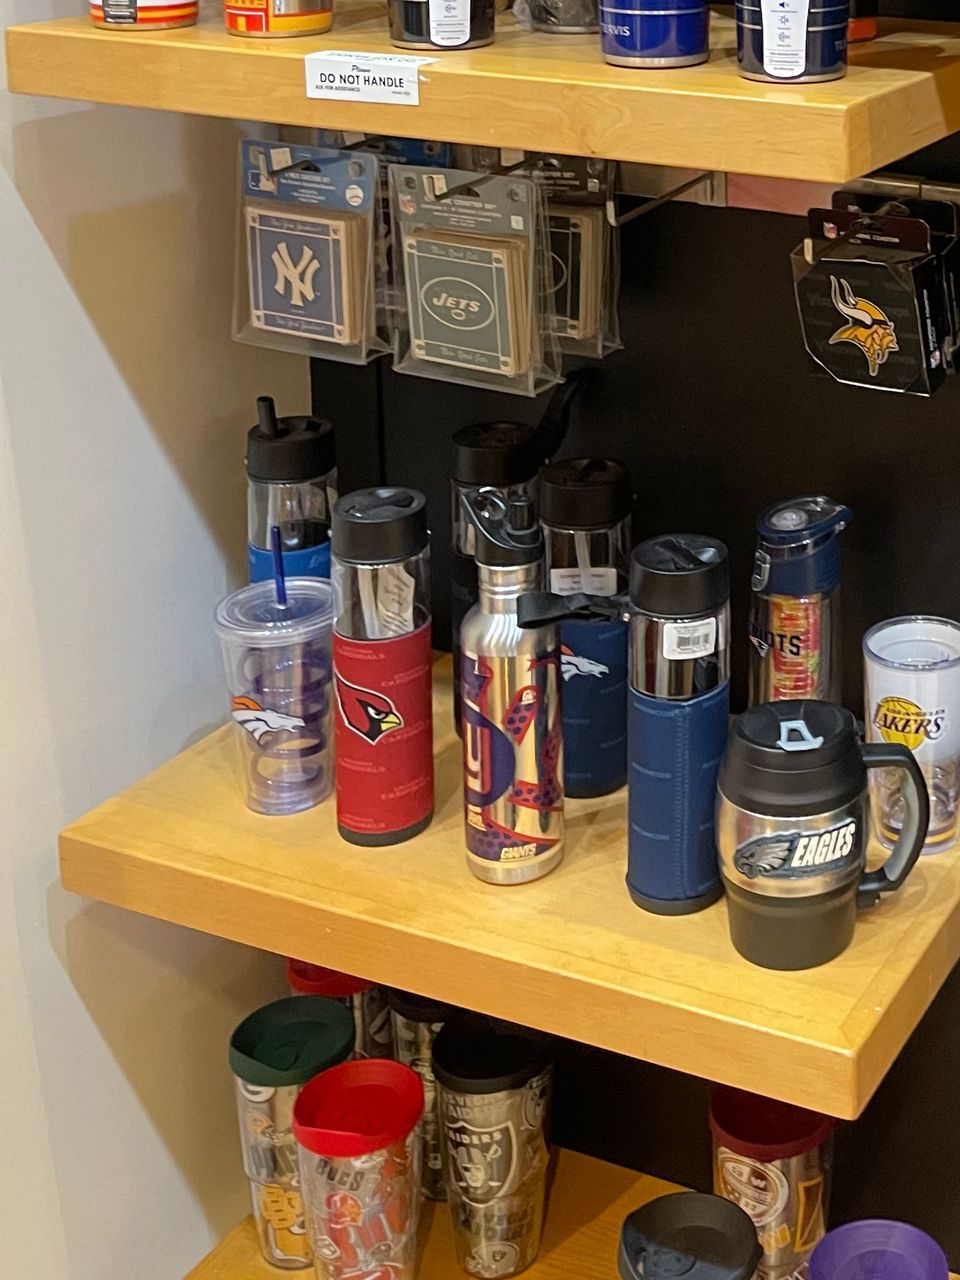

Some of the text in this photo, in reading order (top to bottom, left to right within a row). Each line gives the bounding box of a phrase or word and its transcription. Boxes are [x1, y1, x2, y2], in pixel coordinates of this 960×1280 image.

[319, 73, 404, 88] DO NOT HANDLE
[432, 293, 481, 313] JETS
[500, 843, 537, 860] GIANTS
[791, 822, 856, 868] EAGLES
